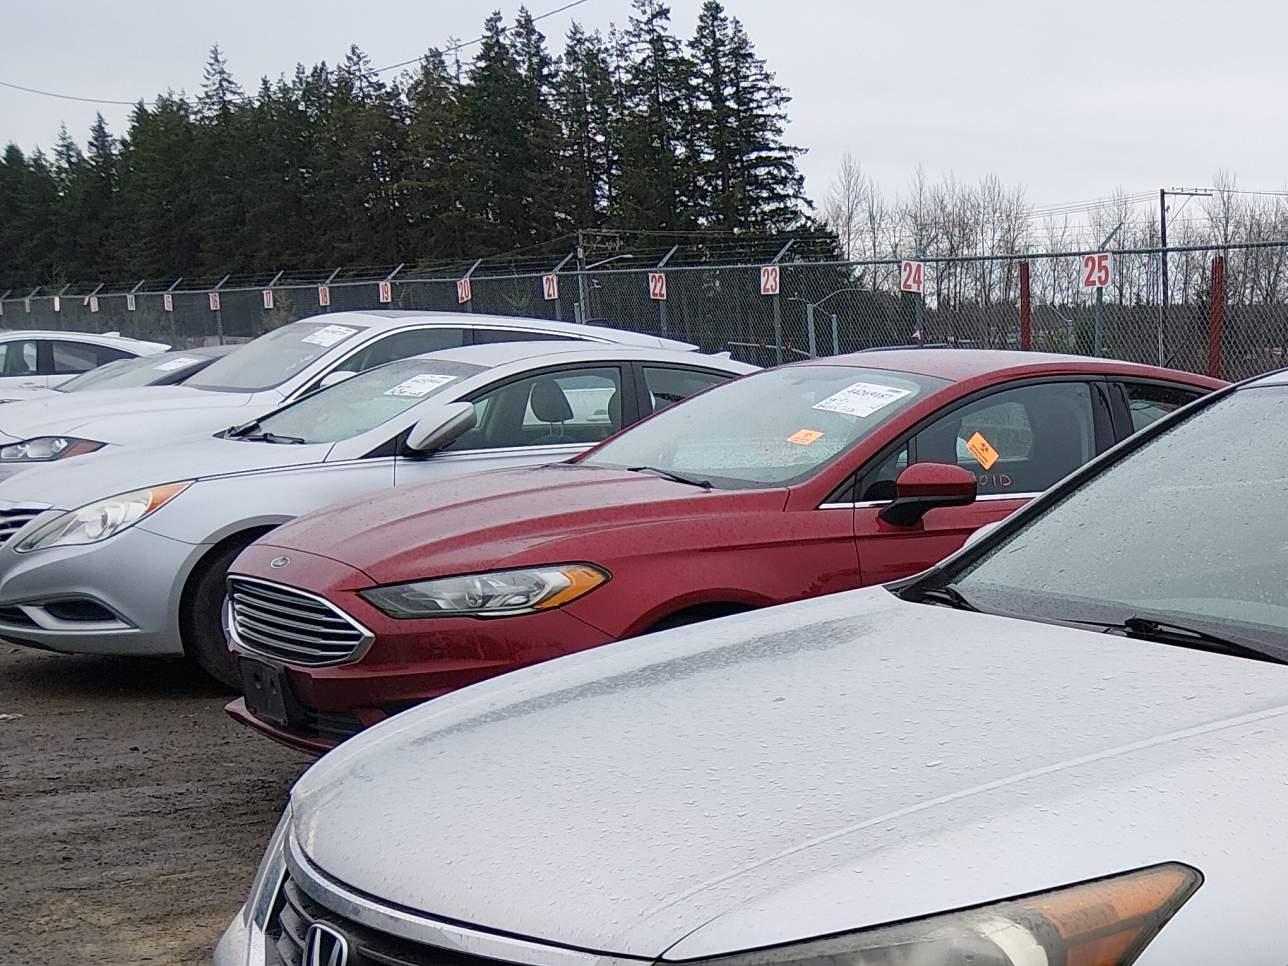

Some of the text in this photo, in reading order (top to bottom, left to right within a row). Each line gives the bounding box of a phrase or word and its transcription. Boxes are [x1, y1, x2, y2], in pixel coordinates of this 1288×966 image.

[763, 268, 778, 293] 23
[902, 262, 922, 291] 24
[1083, 255, 1109, 288] 25
[319, 286, 329, 305] 18
[380, 283, 391, 302] 19
[458, 281, 470, 299] 20
[546, 276, 556, 298] 21
[651, 274, 665, 298] 22
